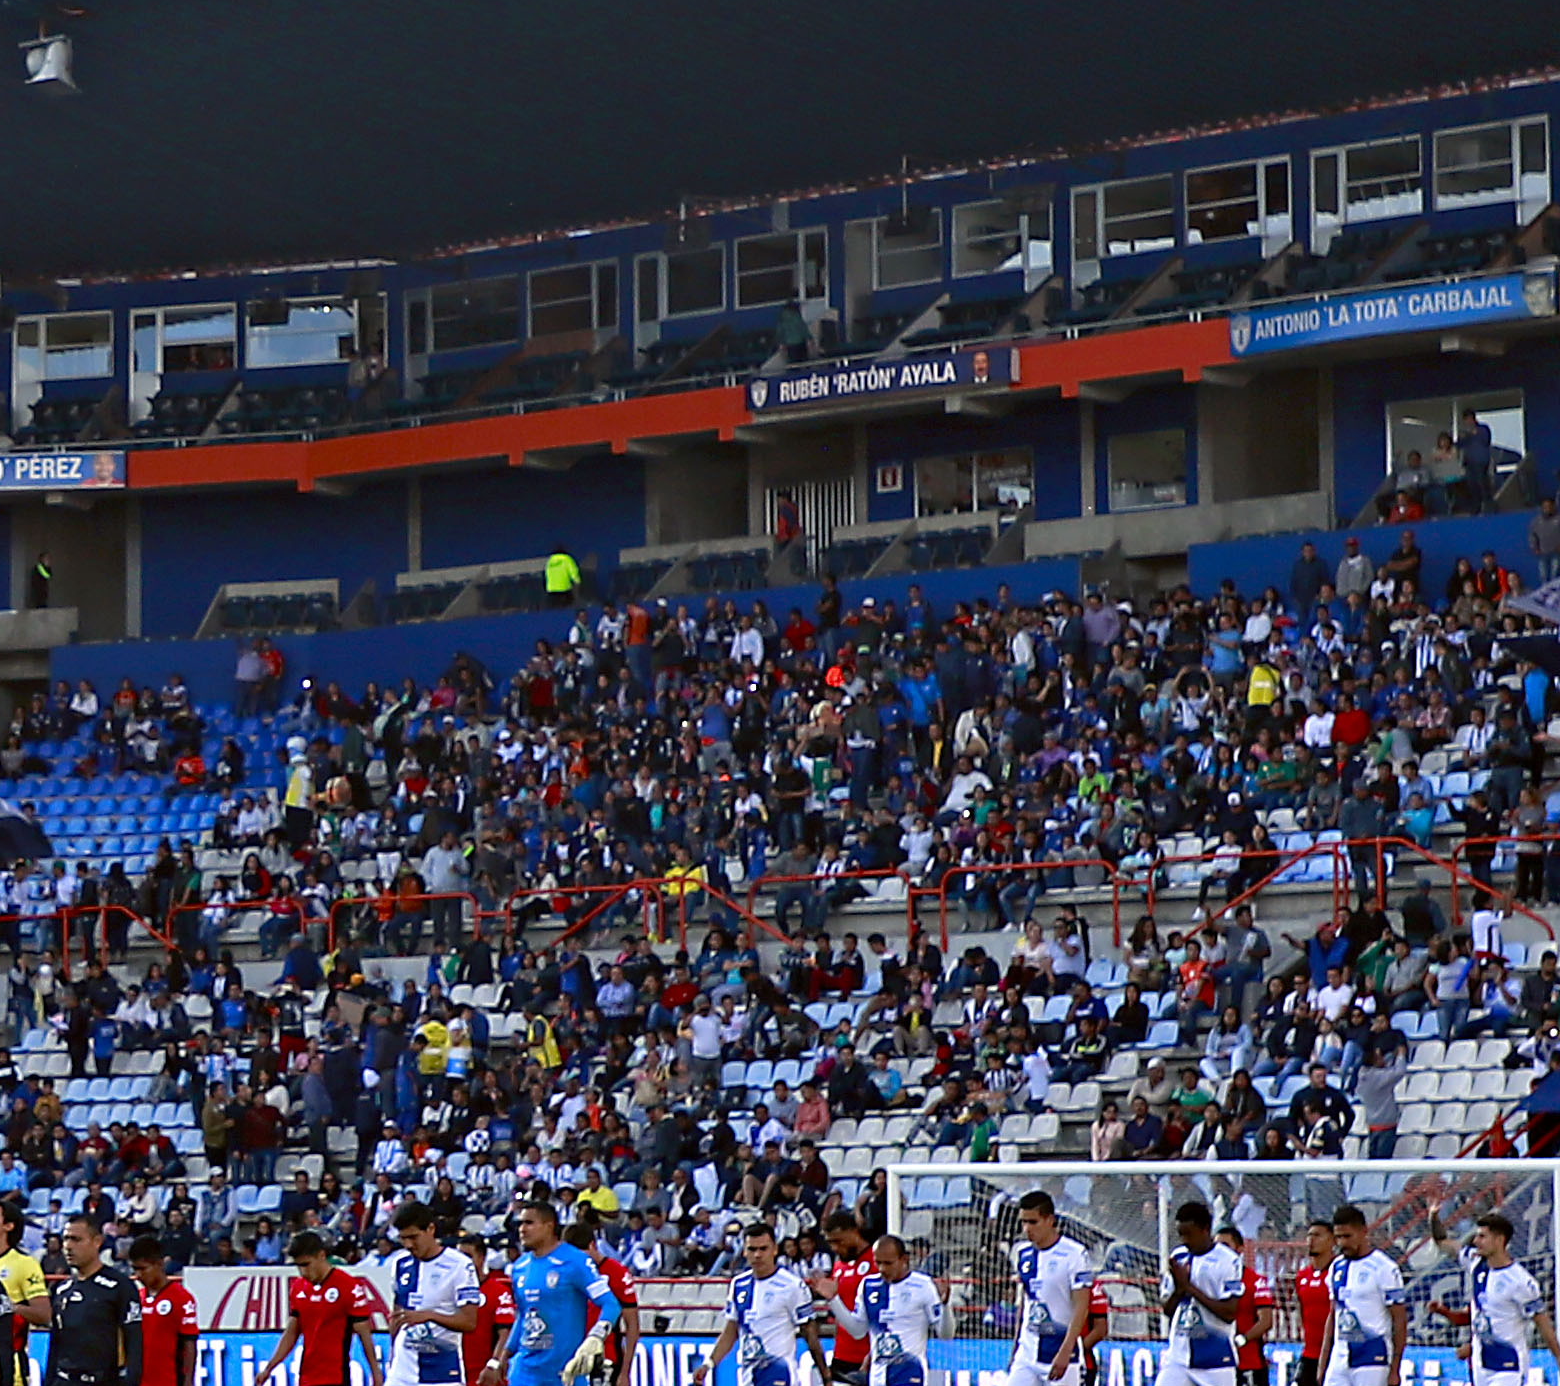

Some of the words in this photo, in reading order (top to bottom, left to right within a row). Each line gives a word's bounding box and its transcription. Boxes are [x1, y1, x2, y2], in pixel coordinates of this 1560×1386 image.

[1254, 309, 1320, 341] ANTONIO
[1408, 285, 1512, 315] CARBAJAL
[779, 372, 829, 403] RUBÉN
[899, 361, 956, 387] AYALA
[15, 454, 83, 480] PÉREZ
